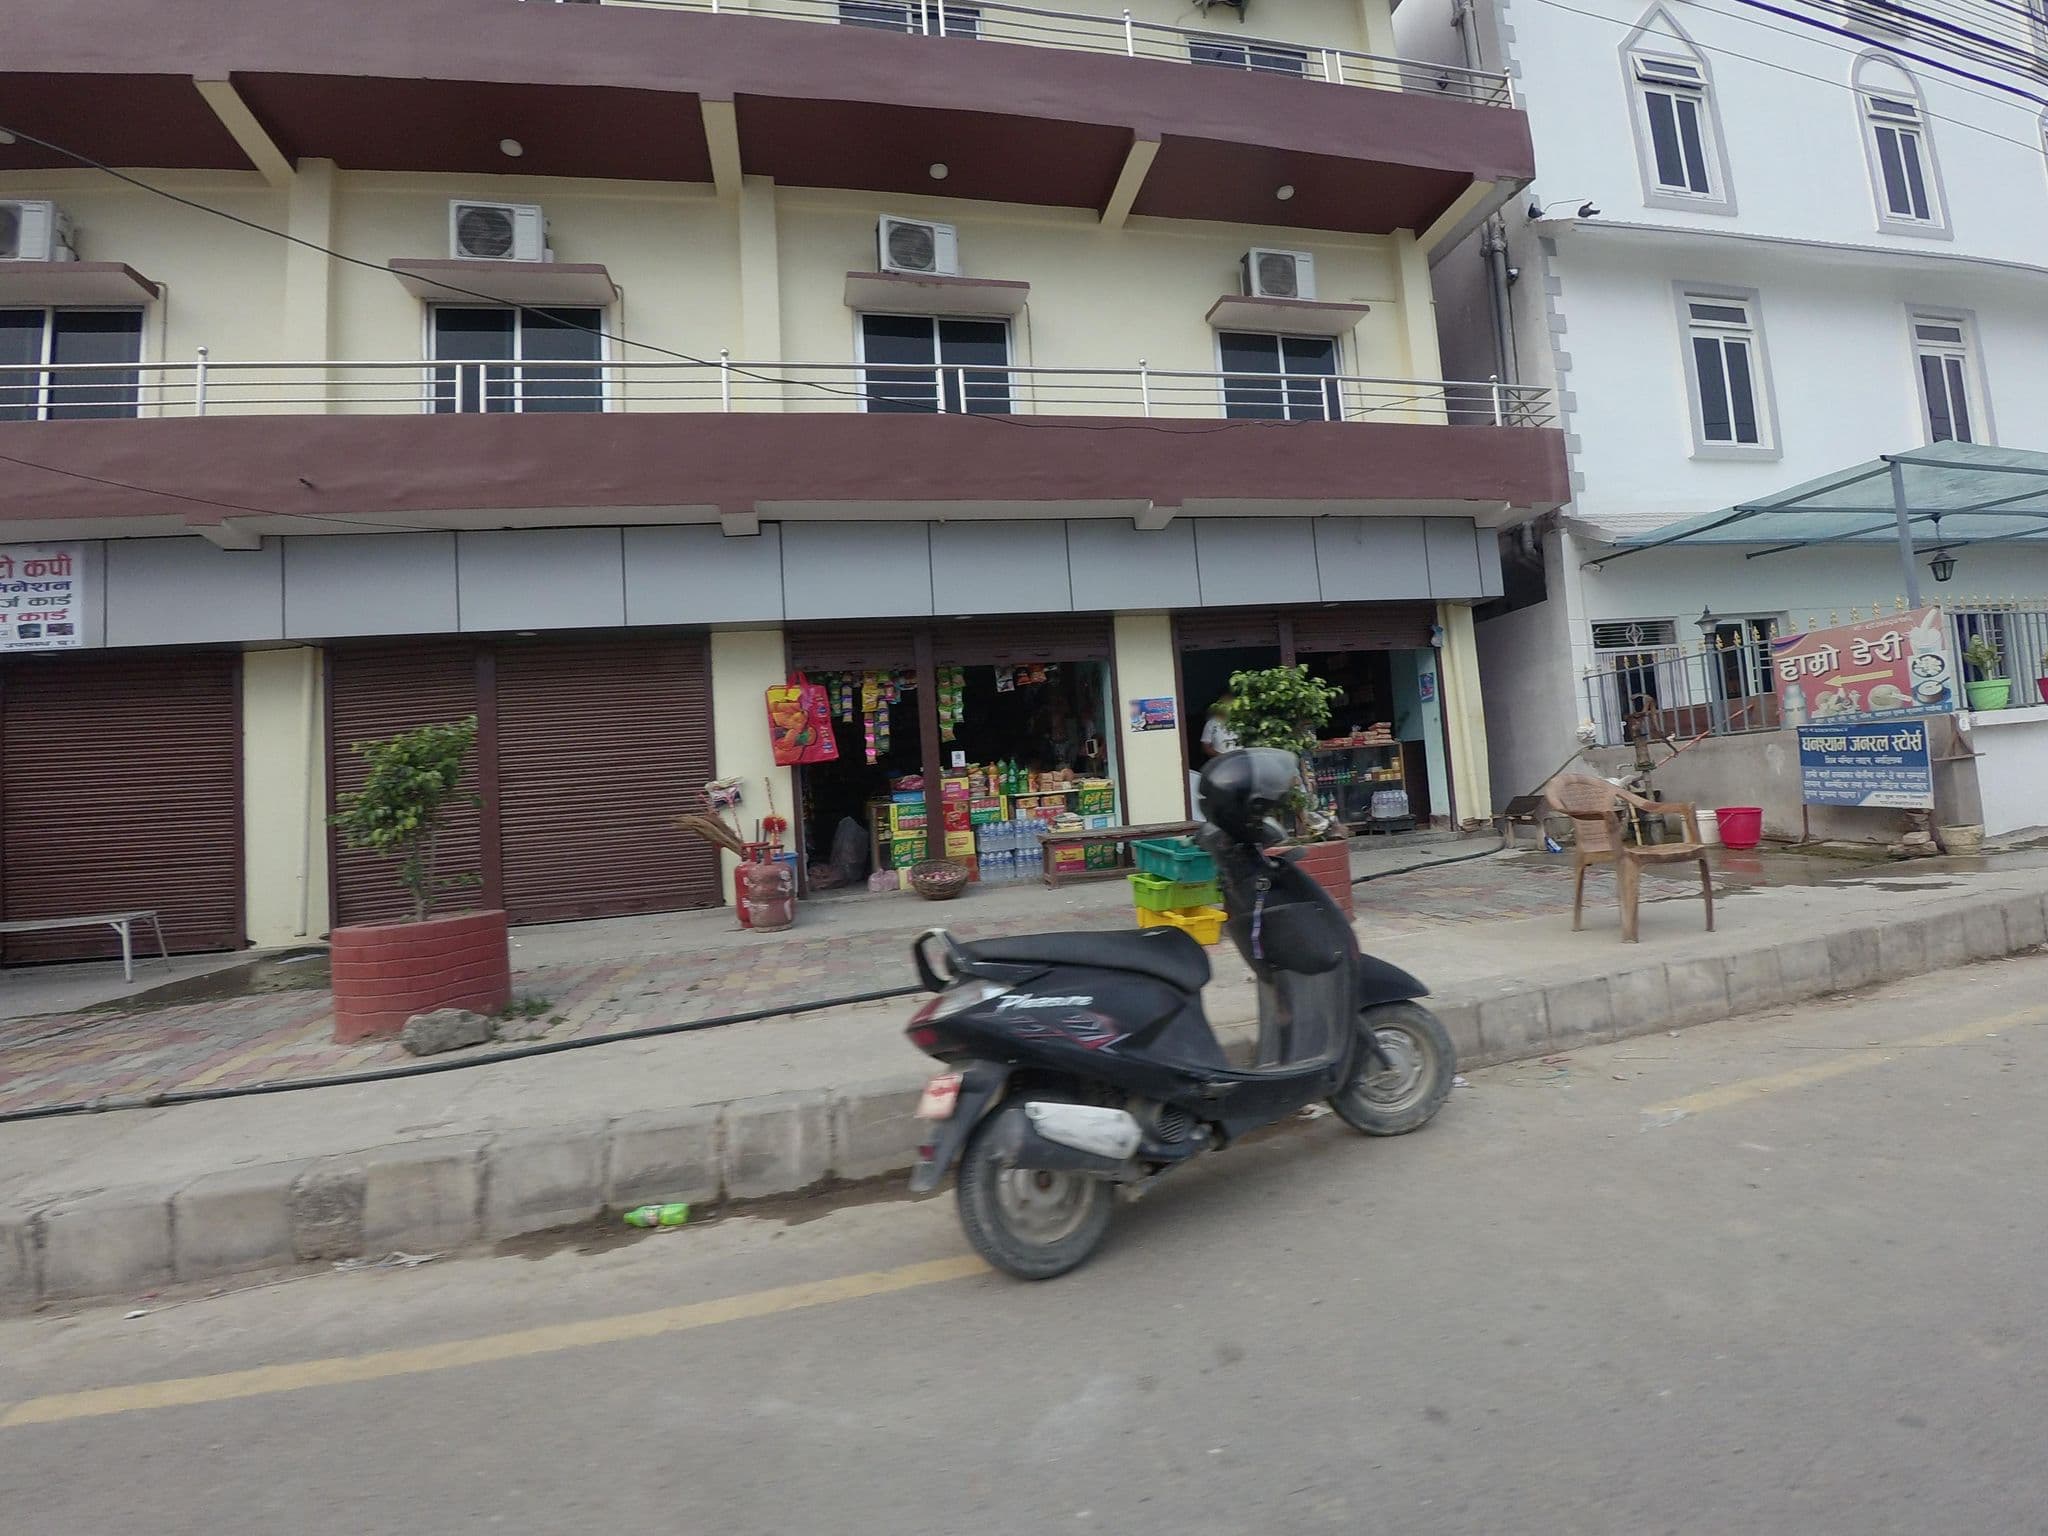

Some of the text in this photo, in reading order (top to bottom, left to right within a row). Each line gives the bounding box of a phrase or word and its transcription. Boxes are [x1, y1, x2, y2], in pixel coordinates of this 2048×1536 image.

[27, 594, 72, 606] कार्ड
[17, 608, 69, 621] कार्ड
[1776, 630, 1904, 682] हाम्रो डेरी
[1848, 734, 1890, 752] जनरल
[1890, 729, 1923, 751] स्टोर्स
